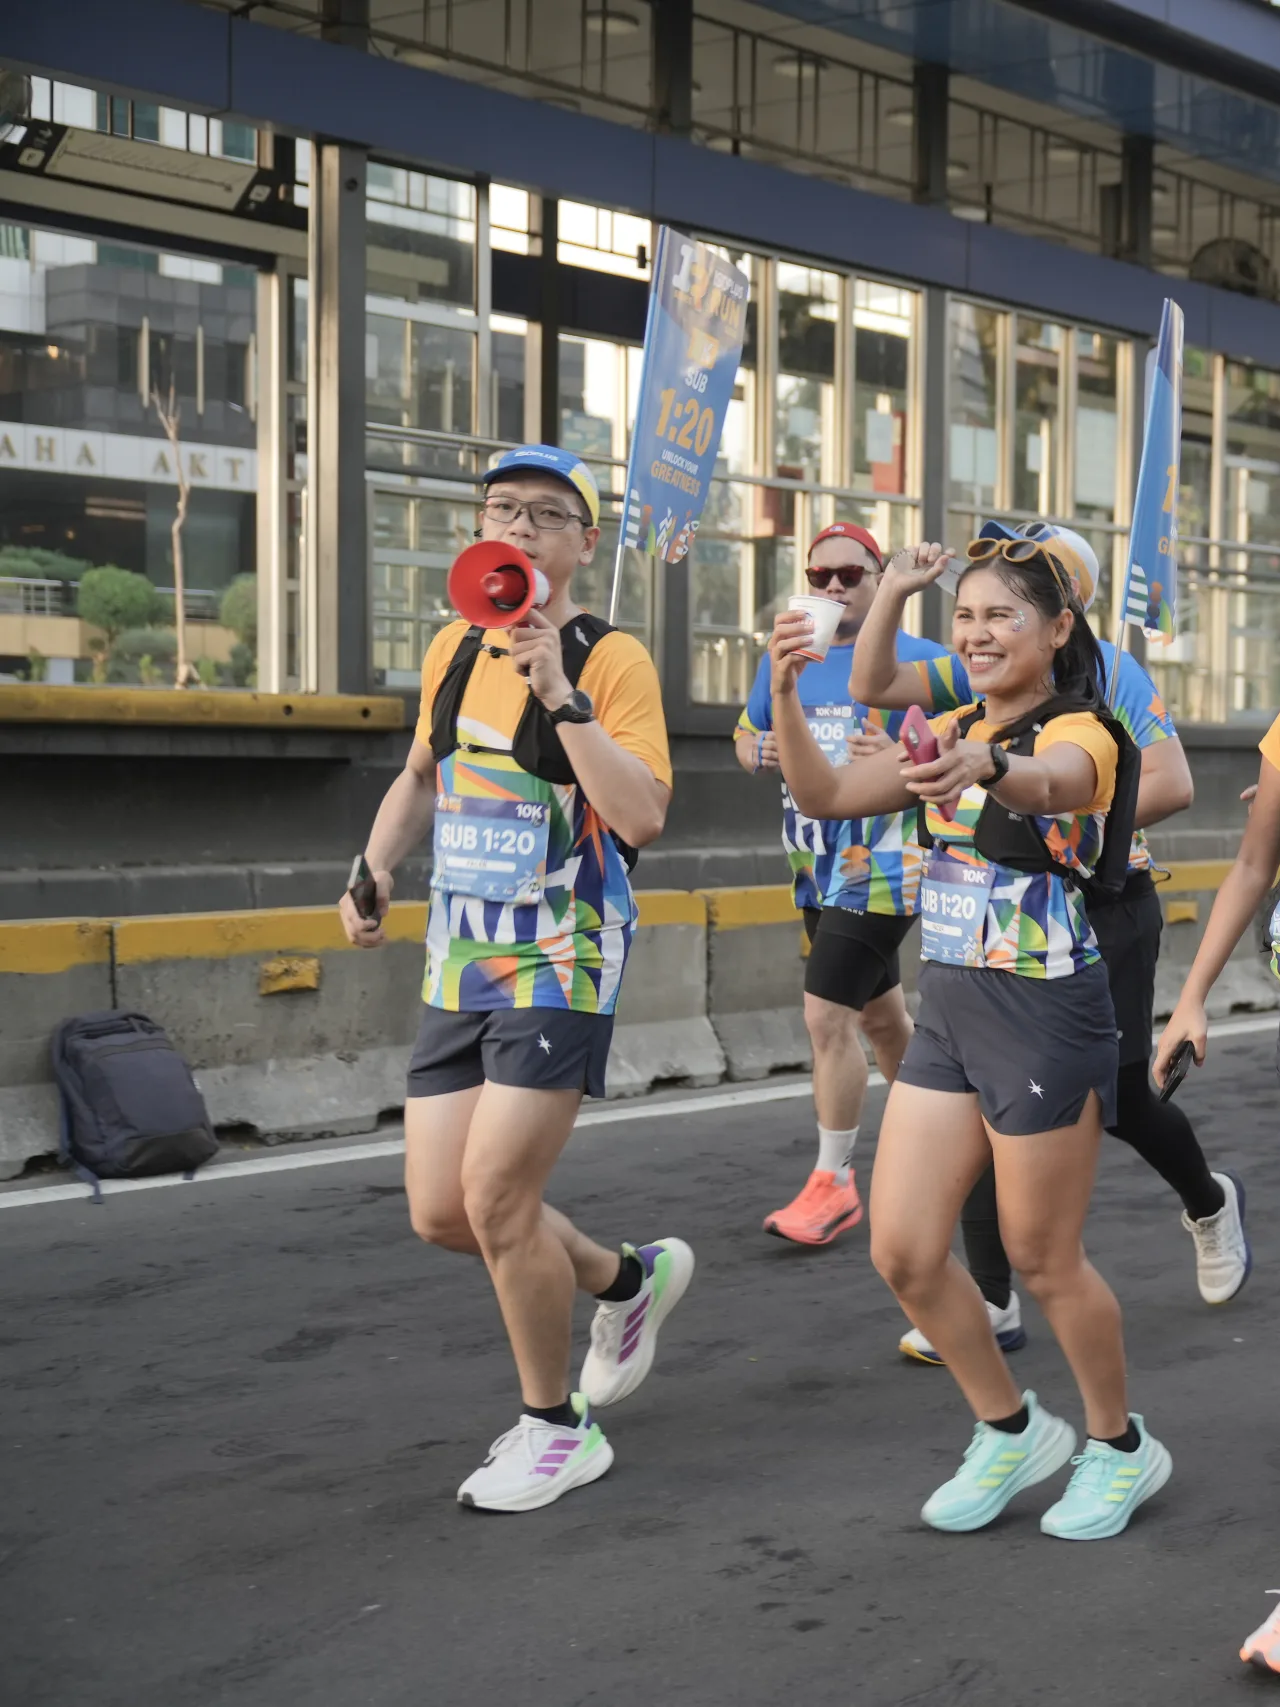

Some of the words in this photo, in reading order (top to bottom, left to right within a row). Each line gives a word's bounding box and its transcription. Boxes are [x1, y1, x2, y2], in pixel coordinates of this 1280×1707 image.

[709, 288, 741, 329] RUN
[685, 366, 709, 393] SUB
[655, 388, 714, 457] 1:20
[661, 448, 685, 471] UNLOCK
[683, 459, 699, 476] YOUR
[651, 460, 702, 498] GREATNESS
[515, 803, 544, 819] 10K
[440, 822, 478, 850] SUB
[482, 828, 536, 855] 1:20
[962, 869, 987, 884] 10K
[940, 892, 976, 920] 1:20
